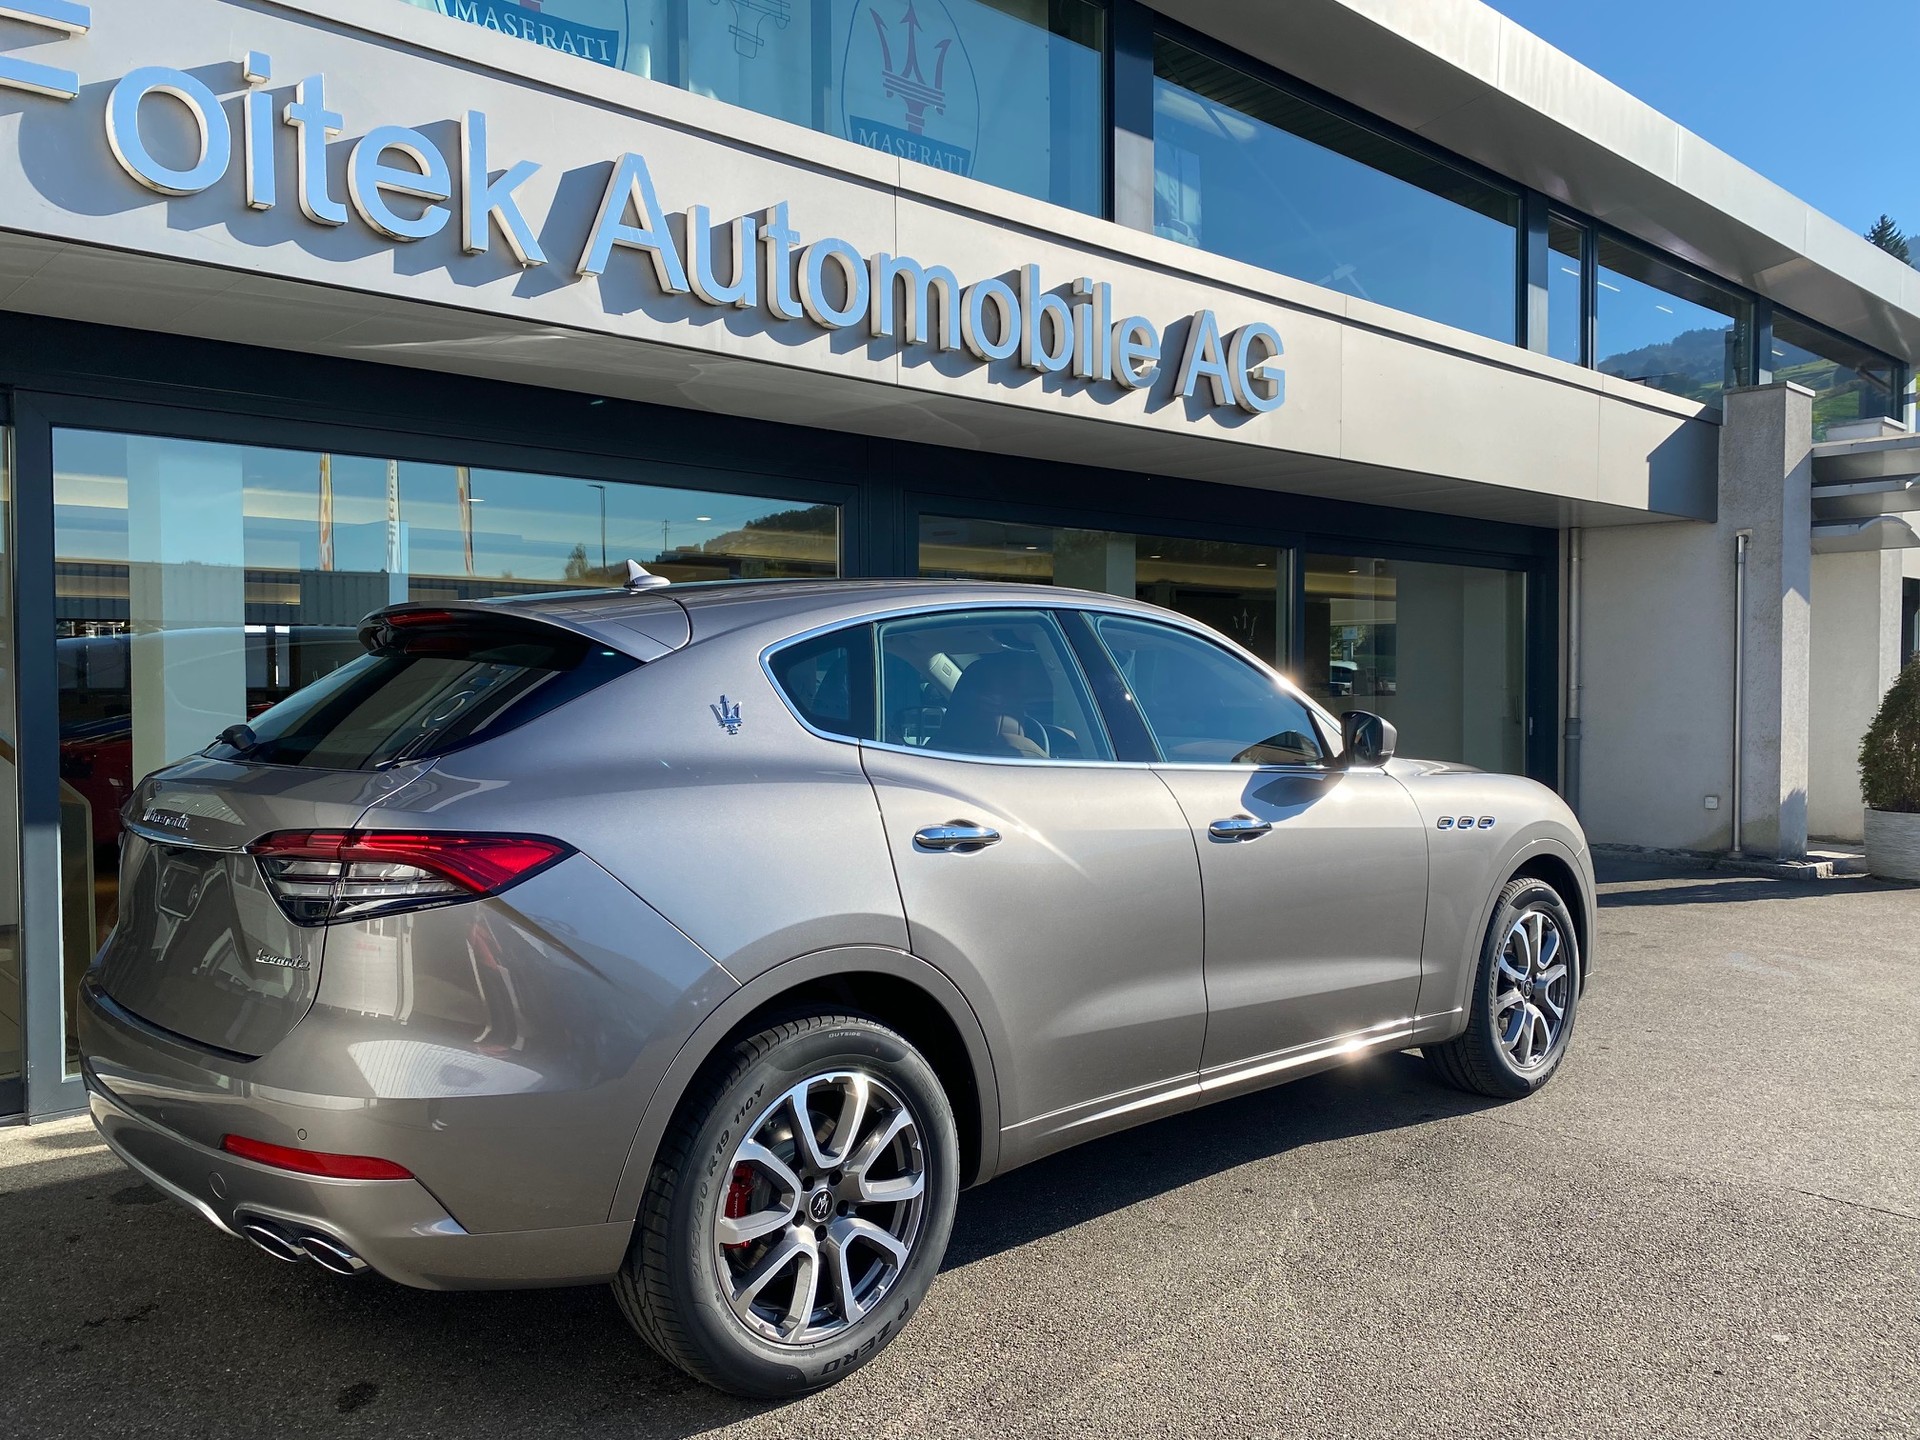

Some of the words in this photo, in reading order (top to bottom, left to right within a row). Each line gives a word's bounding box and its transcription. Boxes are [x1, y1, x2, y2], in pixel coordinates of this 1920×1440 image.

[453, 0, 611, 62] MASERATI
[858, 127, 964, 175] MASERATI
[575, 152, 1161, 390] Automobile
[1174, 309, 1286, 414] AG
[820, 1320, 892, 1376] ZERO
